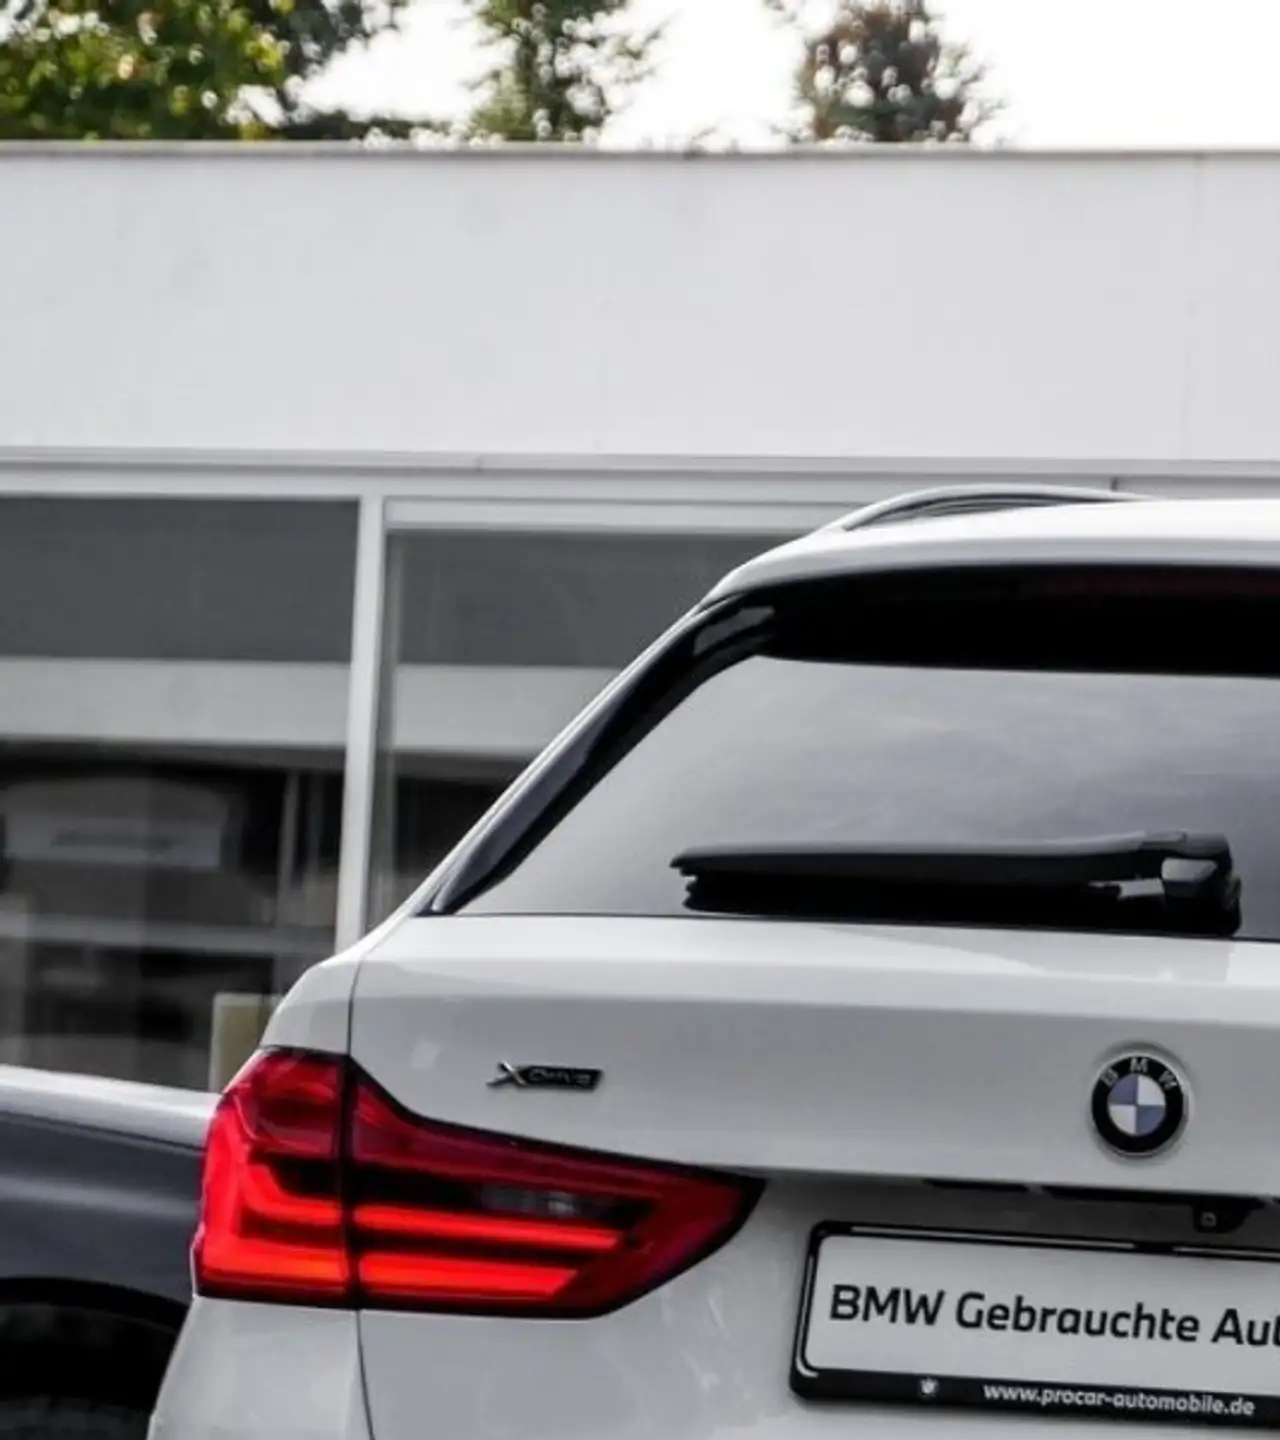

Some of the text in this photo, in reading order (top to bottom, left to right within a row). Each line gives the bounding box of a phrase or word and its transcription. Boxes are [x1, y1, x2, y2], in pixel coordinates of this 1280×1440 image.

[829, 1283, 945, 1326] BMW
[954, 1290, 1200, 1343] Gebrauchte
[983, 1384, 1256, 1417] www.procar-automobile.de
